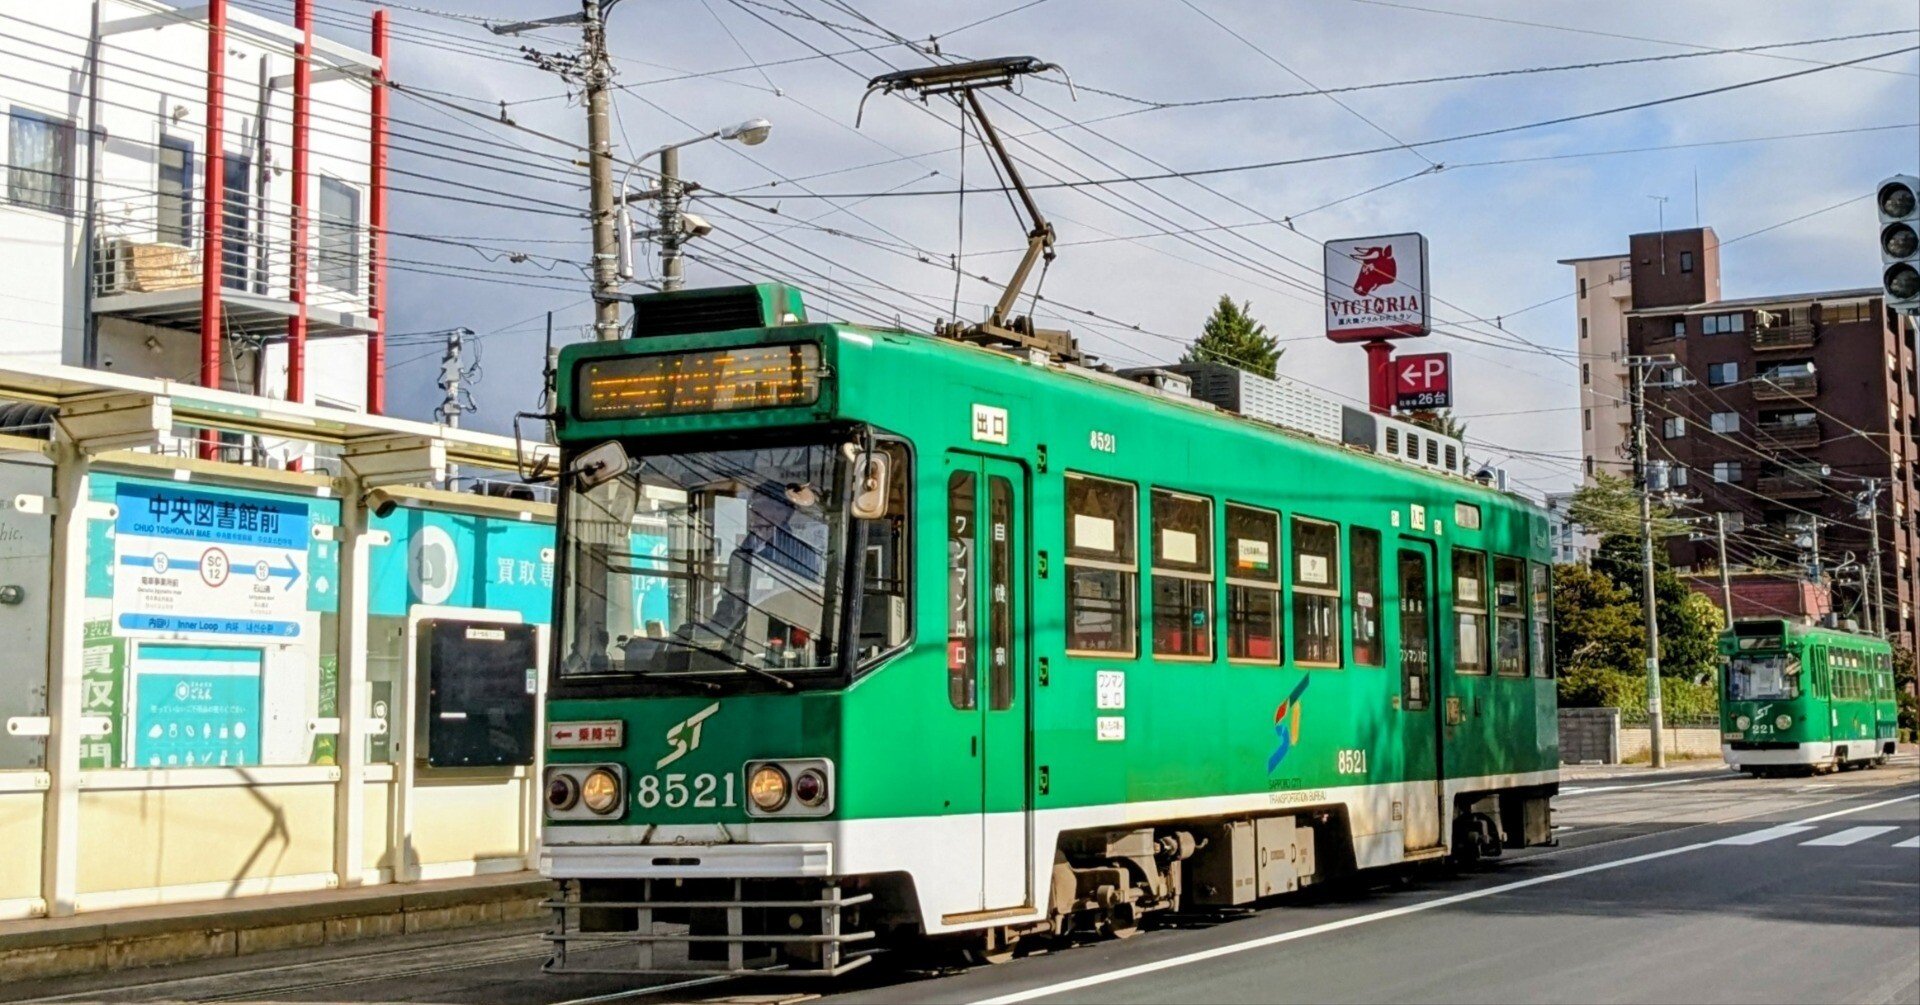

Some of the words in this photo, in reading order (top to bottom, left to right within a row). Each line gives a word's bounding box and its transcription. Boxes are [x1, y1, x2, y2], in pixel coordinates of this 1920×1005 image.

[1331, 295, 1419, 317] VICTORIA
[1425, 359, 1445, 388] P
[976, 412, 1005, 437] 出口
[1090, 431, 1116, 453] 8521
[149, 493, 279, 534] 中央図書館前
[1413, 509, 1424, 525] 入口
[134, 523, 155, 532] CHUO
[157, 525, 195, 536] TOSHOKAN
[196, 530, 211, 538] MAE
[207, 556, 222, 567] SC
[209, 569, 220, 579] 12
[956, 515, 967, 664] ワンマン出口
[177, 619, 197, 630] Inner
[199, 620, 219, 631] Loop
[1099, 674, 1124, 688] ワンマン
[578, 727, 617, 741] 乗降中
[1752, 724, 1775, 734] 221
[1338, 749, 1368, 774] 8521
[637, 772, 738, 808] 8521
